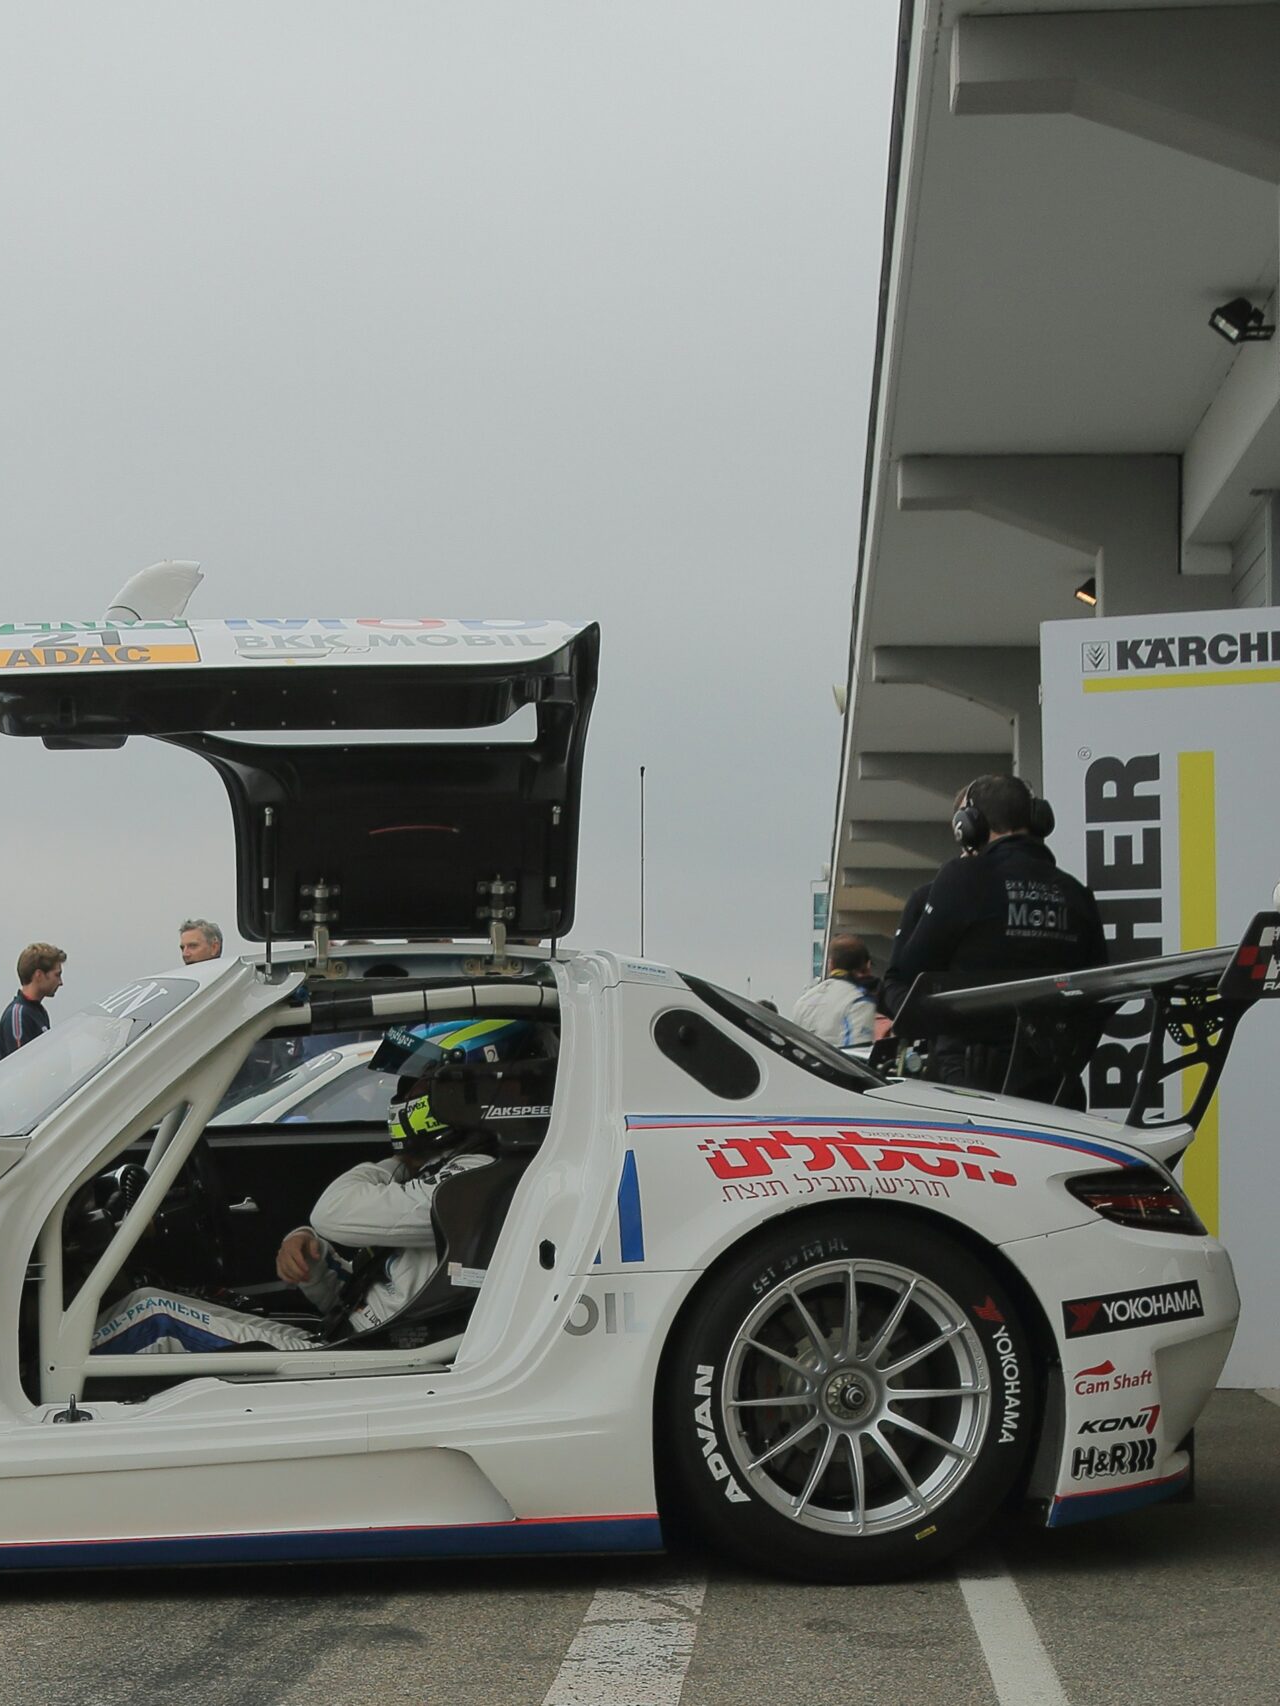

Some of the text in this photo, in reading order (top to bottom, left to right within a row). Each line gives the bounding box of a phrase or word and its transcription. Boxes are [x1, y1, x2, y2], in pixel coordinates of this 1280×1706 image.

[234, 633, 547, 649] BKK MOBIL
[6, 646, 151, 668] ADAC
[1008, 902, 1068, 930] Mobil
[481, 1105, 553, 1120] ZAKSPEE
[92, 1297, 210, 1340] OBIL-PRÄMIE.DE
[1102, 1289, 1201, 1323] YOKOHAMA
[992, 1325, 1021, 1443] YOKOHAMA
[1075, 1370, 1152, 1395] Cam Shaft
[694, 1364, 752, 1503] ADVAN
[1077, 1404, 1160, 1434] KONI
[1071, 1442, 1134, 1480] H&R
